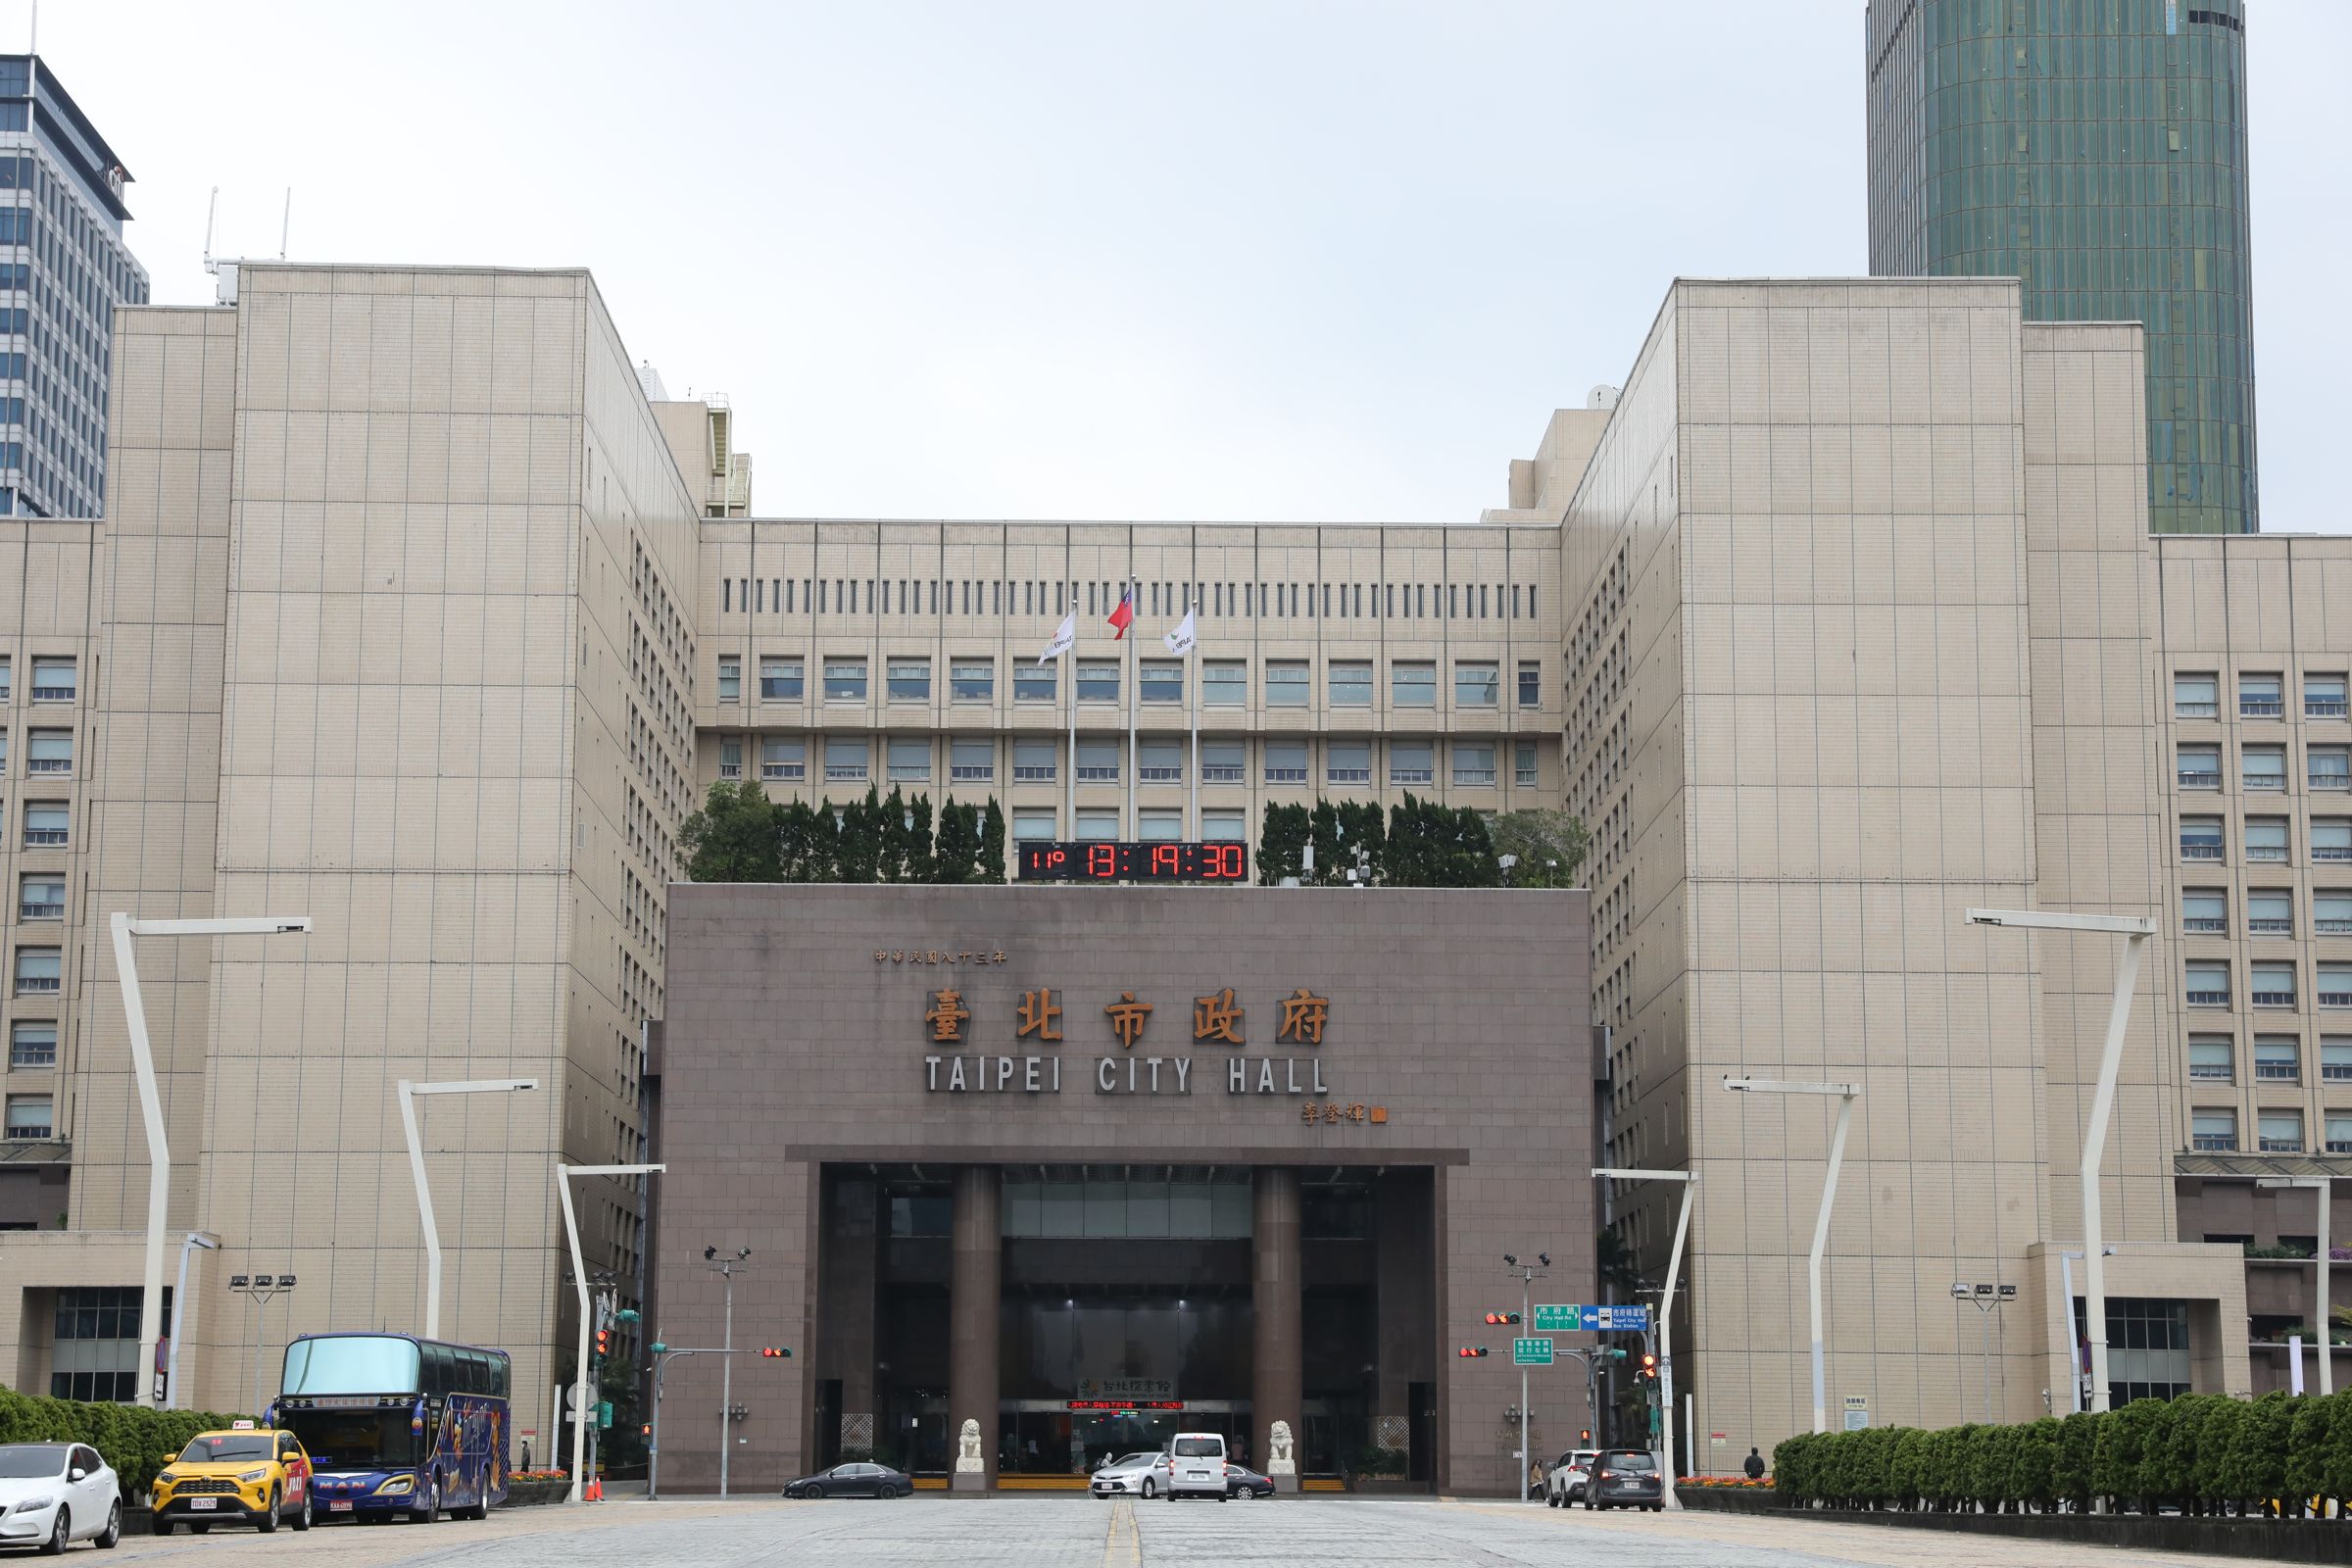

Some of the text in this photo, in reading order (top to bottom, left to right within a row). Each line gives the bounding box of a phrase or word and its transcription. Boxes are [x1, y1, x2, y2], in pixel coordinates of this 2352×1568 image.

[875, 949, 1006, 964] 中華民國八十三年
[925, 988, 1329, 1049] 臺北市政府
[925, 1055, 1328, 1093] TAIPEI CITY HALL
[1301, 1102, 1364, 1125] 李登輝
[1540, 1306, 1575, 1315] 市府路
[1103, 1380, 1171, 1392] 台北探索館
[319, 1481, 366, 1490] MAN
